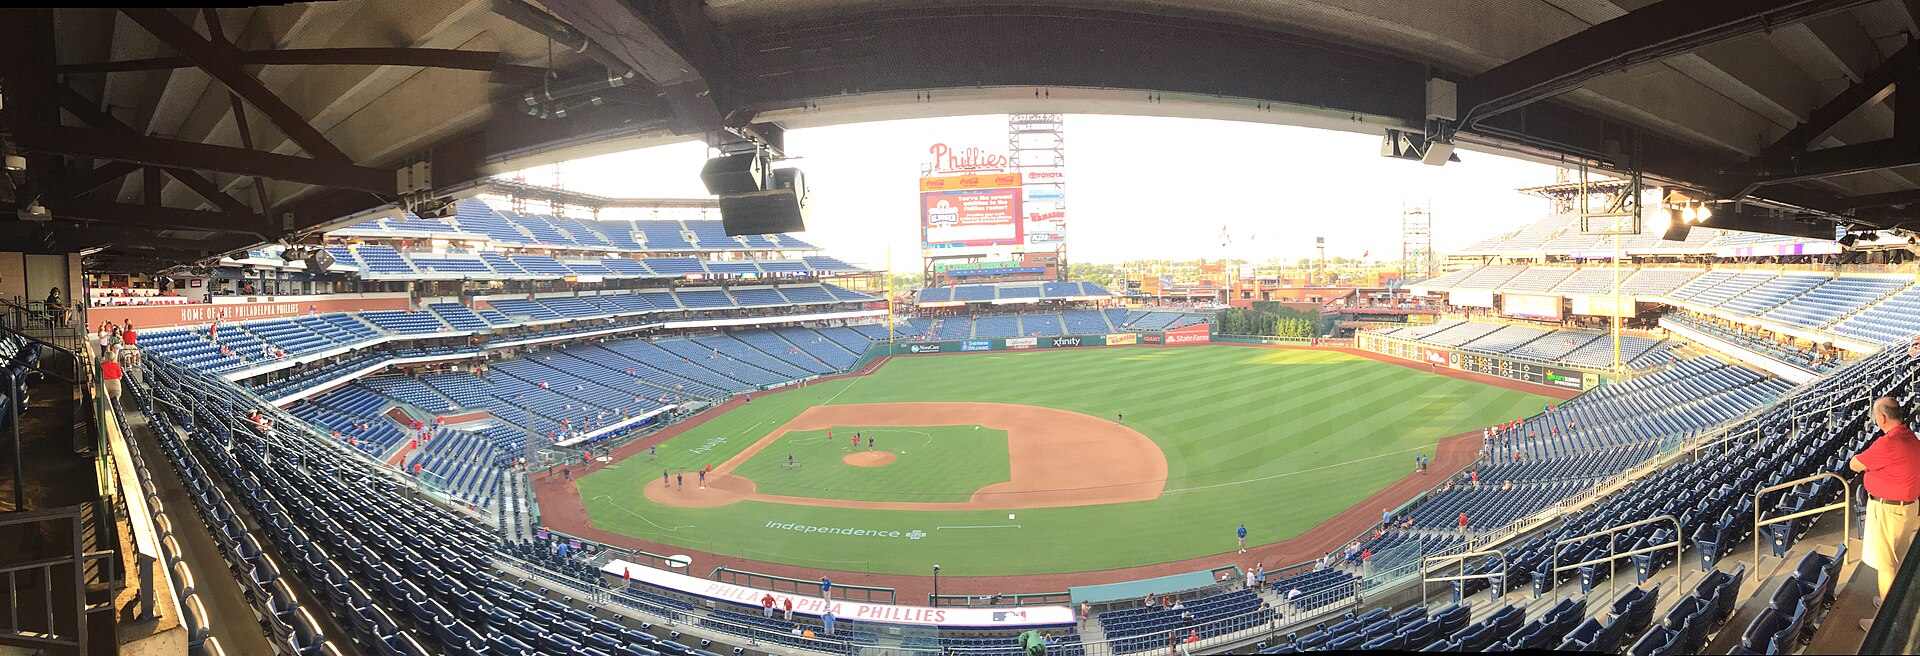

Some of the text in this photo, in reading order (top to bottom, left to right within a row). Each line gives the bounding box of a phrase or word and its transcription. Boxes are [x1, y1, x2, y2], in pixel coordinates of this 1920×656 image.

[929, 143, 1007, 169] Phillies
[181, 308, 204, 321] HOME
[207, 307, 216, 319] OF
[1053, 337, 1080, 347] xfinity
[764, 520, 900, 538] Independence
[857, 604, 947, 623] PHILLIES
